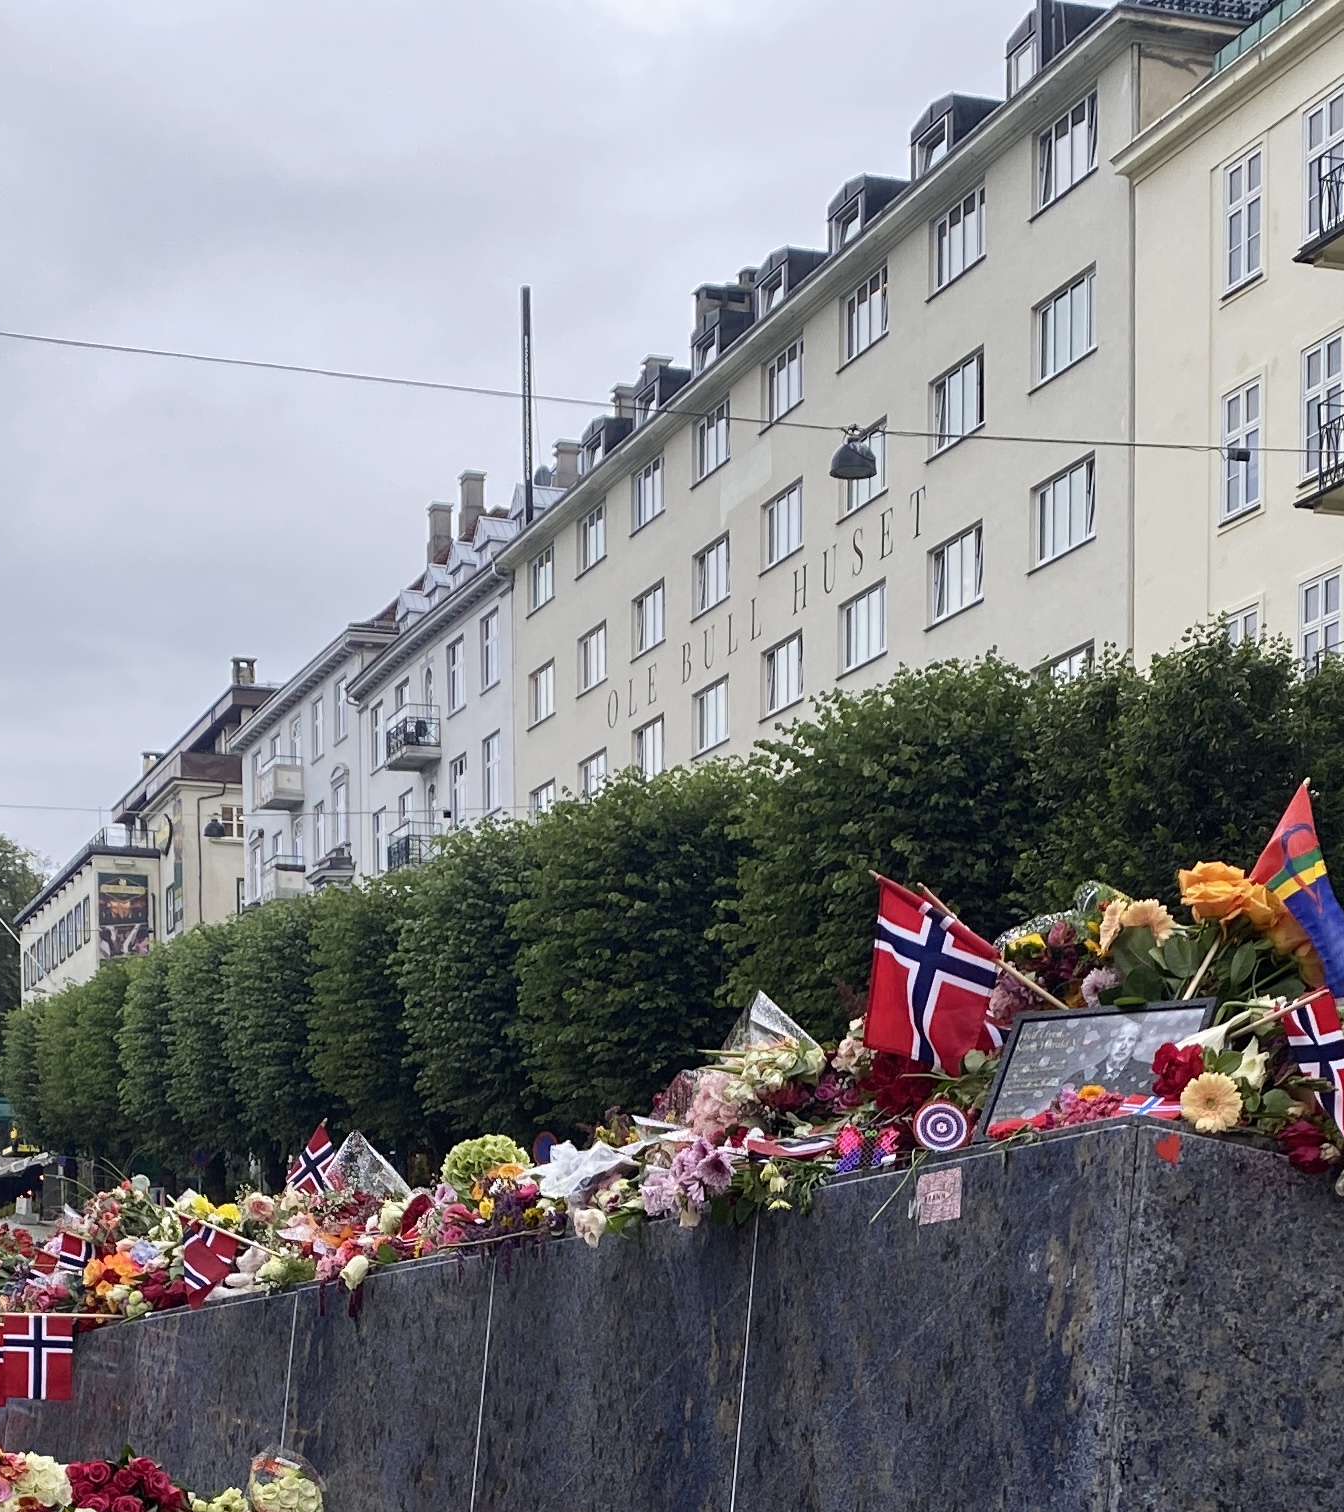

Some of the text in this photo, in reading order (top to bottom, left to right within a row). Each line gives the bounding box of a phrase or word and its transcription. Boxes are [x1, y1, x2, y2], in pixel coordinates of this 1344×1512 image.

[607, 485, 927, 729] OLE BULL HUSET
[1015, 1041, 1037, 1052] Kong
[1040, 1038, 1071, 1050] Harald
